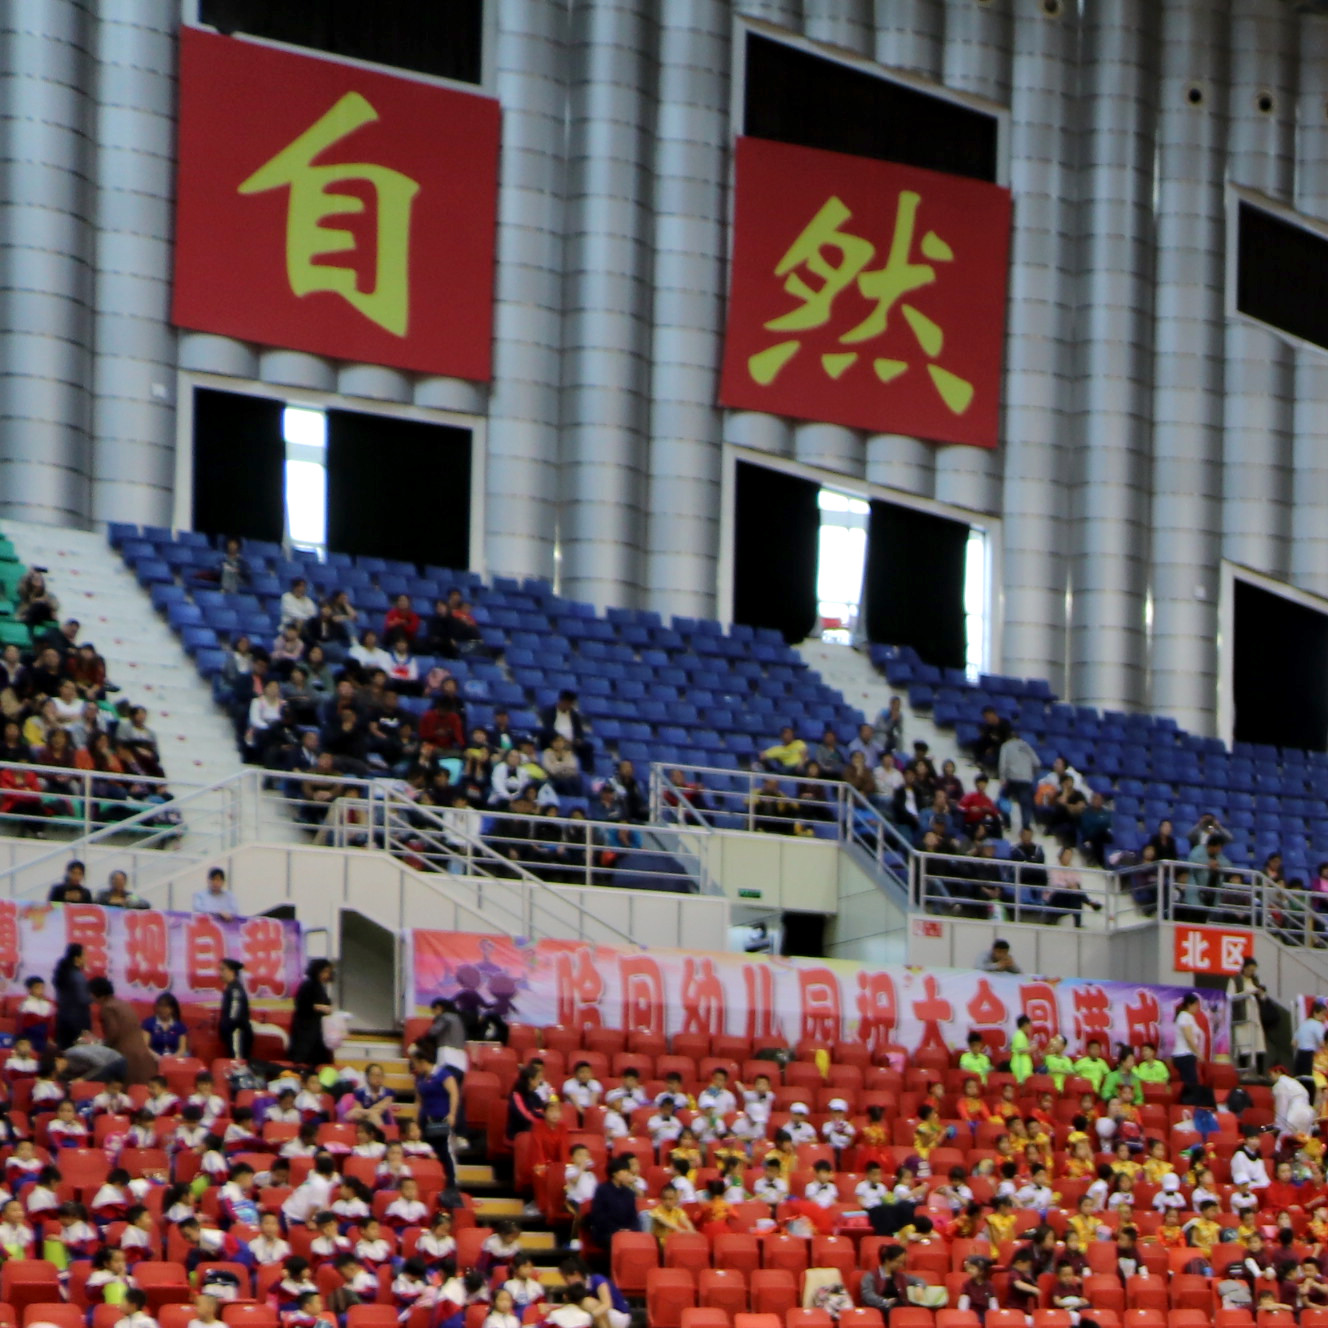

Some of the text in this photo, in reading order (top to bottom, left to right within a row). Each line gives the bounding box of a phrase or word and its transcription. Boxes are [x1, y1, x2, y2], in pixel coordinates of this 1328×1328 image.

[237, 91, 420, 337] 自
[747, 190, 974, 415] 然
[1180, 931, 1248, 971] 北区
